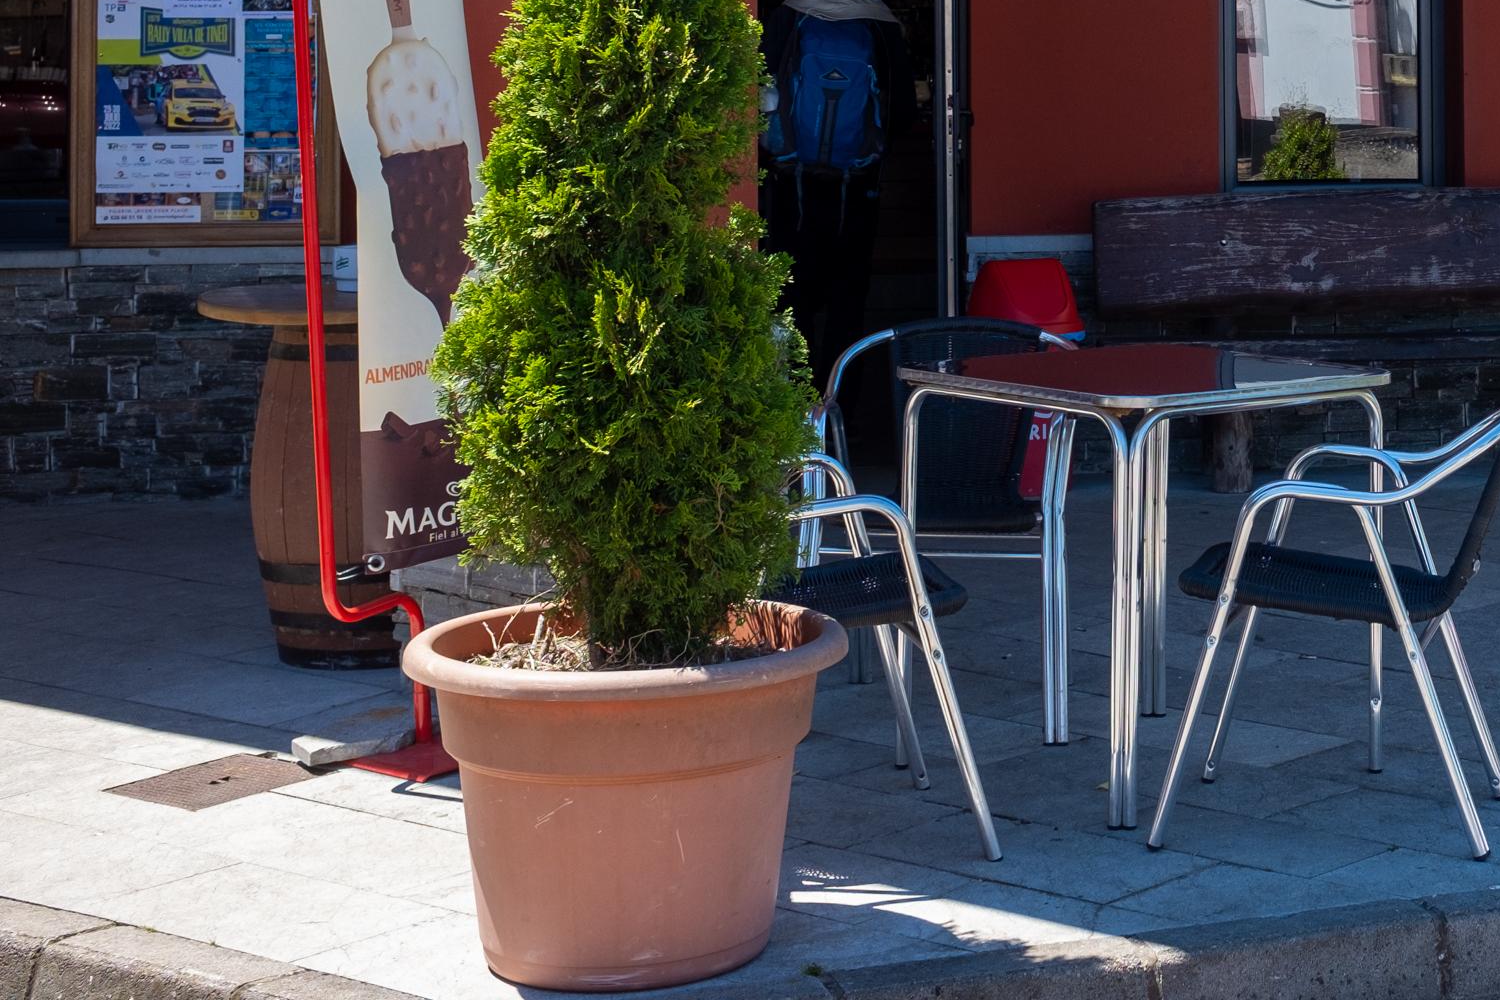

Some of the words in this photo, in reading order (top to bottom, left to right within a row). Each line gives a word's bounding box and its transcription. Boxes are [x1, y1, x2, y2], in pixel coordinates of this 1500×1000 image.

[147, 23, 170, 42] RALLY
[172, 26, 193, 42] VILLA
[194, 26, 205, 42] DE
[207, 23, 228, 42] TINEO
[365, 358, 434, 384] ALMENDRA
[385, 501, 457, 540] MAG
[429, 530, 447, 542] Fiel
[451, 527, 459, 538] al
